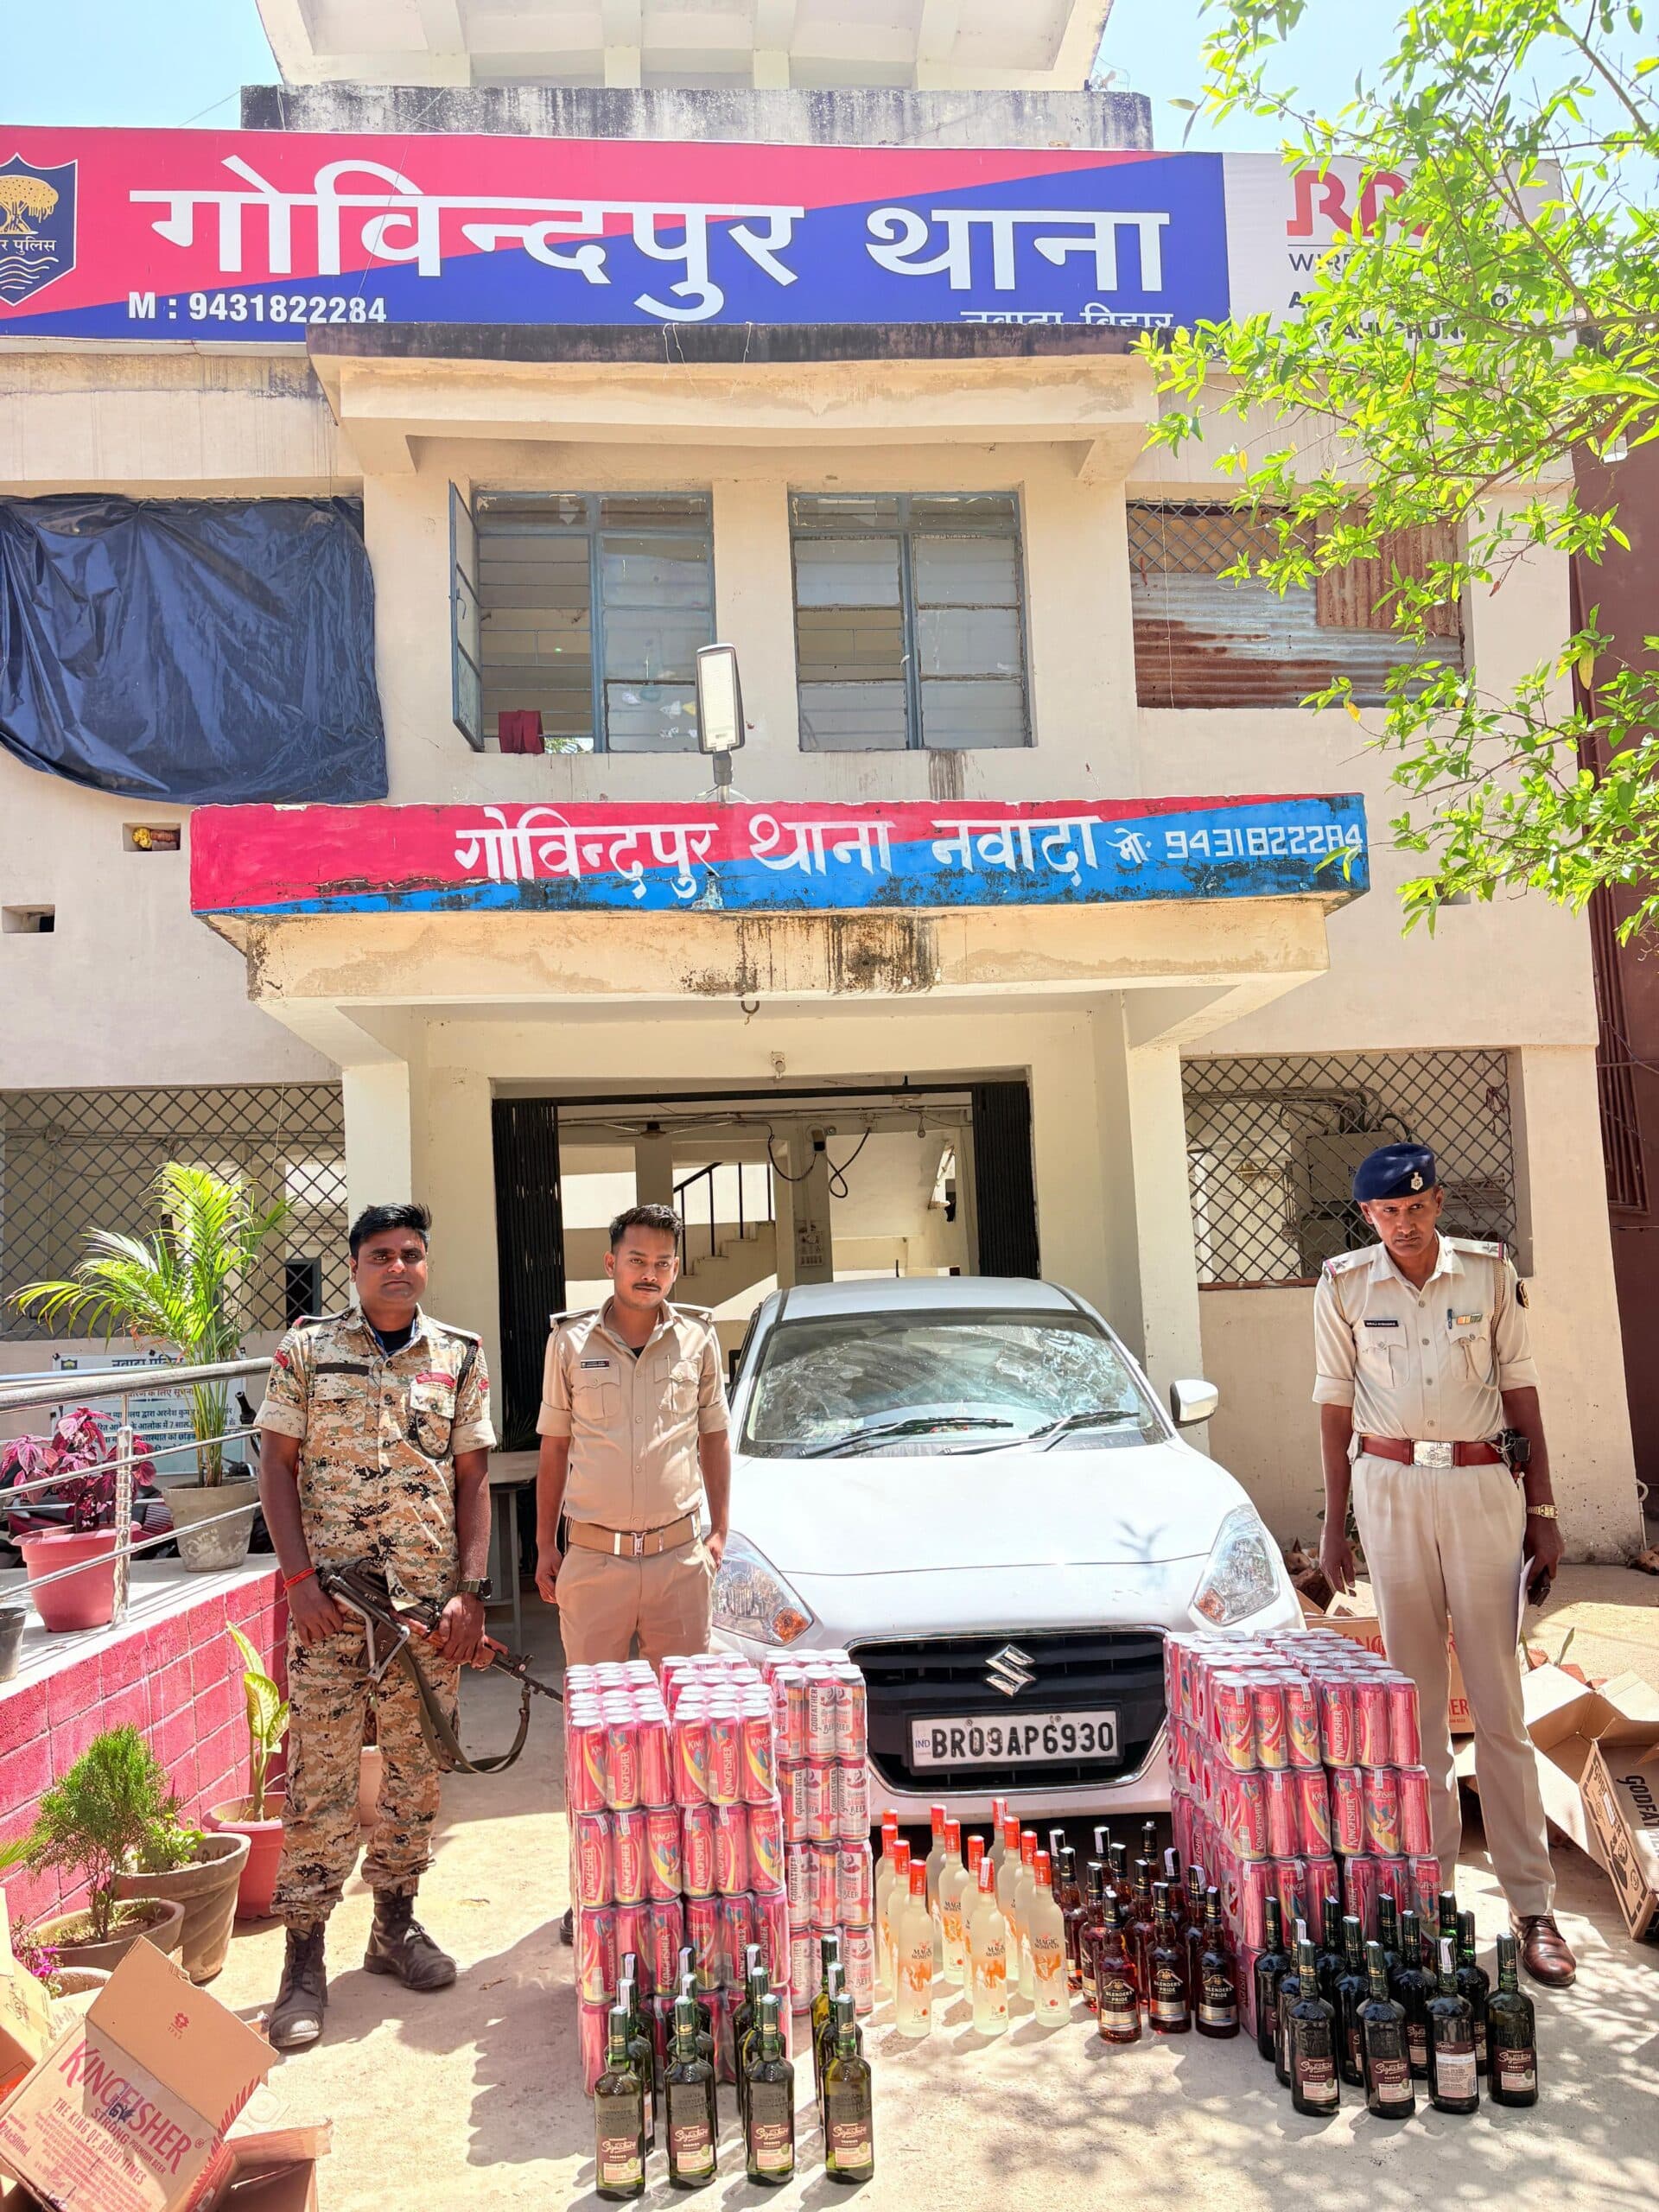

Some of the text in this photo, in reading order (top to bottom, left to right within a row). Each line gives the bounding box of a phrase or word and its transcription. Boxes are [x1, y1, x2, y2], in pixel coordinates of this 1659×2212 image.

[12, 235, 57, 256] पुलिस
[130, 154, 1170, 322] गोविन्दपुर थाना
[128, 292, 156, 320] M
[188, 293, 387, 324] 9431822284
[454, 806, 721, 899] गोविन्दपुर
[748, 813, 897, 876] थाना
[1166, 823, 1363, 861] 9431822284
[914, 1721, 1114, 1759] IND BR09AP6930
[1333, 1709, 1346, 1758] KINGFISHER
[621, 1751, 632, 1800] KINGFISHER
[723, 1745, 734, 1796] KINGFISHER
[795, 1770, 804, 1815] GODFATHER
[1255, 1800, 1266, 1850] KINGFISHER
[1346, 1796, 1358, 1847] KINGFISHER
[584, 1846, 596, 1897] KINGFISHER
[621, 1843, 632, 1895] KINGFISHER
[694, 1836, 707, 1887] KINGFISHER
[661, 1933, 673, 1986] KINGFISHER
[1300, 2061, 1333, 2074] Signature
[1374, 2062, 1408, 2075] Signature
[1497, 2050, 1532, 2065] Signature
[58, 2038, 192, 2175] KINGFISHER
[91, 2107, 130, 2145] STRONG
[53, 2096, 147, 2186] THE KING OF GOOD TIMES
[601, 2140, 637, 2154] Signature
[674, 2127, 709, 2143] Signature
[754, 2126, 789, 2140] Signature
[832, 2125, 868, 2139] Signature
